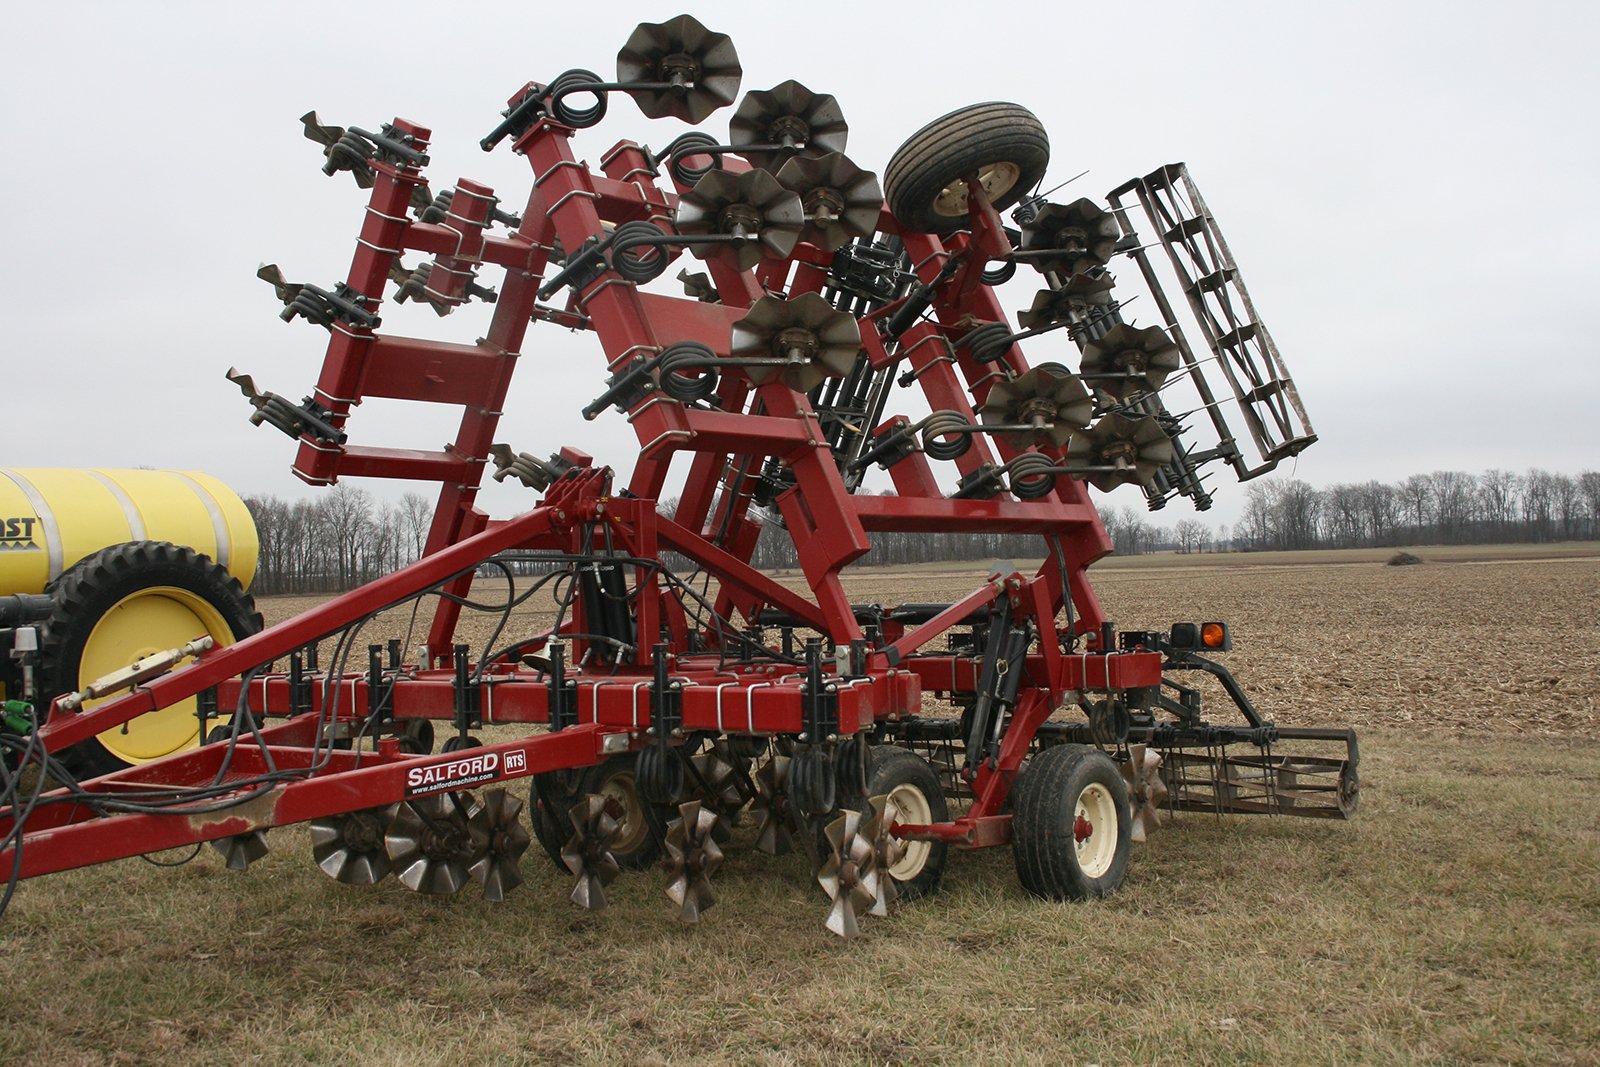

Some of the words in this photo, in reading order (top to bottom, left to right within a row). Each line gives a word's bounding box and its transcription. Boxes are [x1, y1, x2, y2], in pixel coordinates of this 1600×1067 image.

[408, 753, 498, 786] SALFORD
[506, 754, 524, 769] RTS
[412, 772, 493, 794] www.salfordmachine.com
